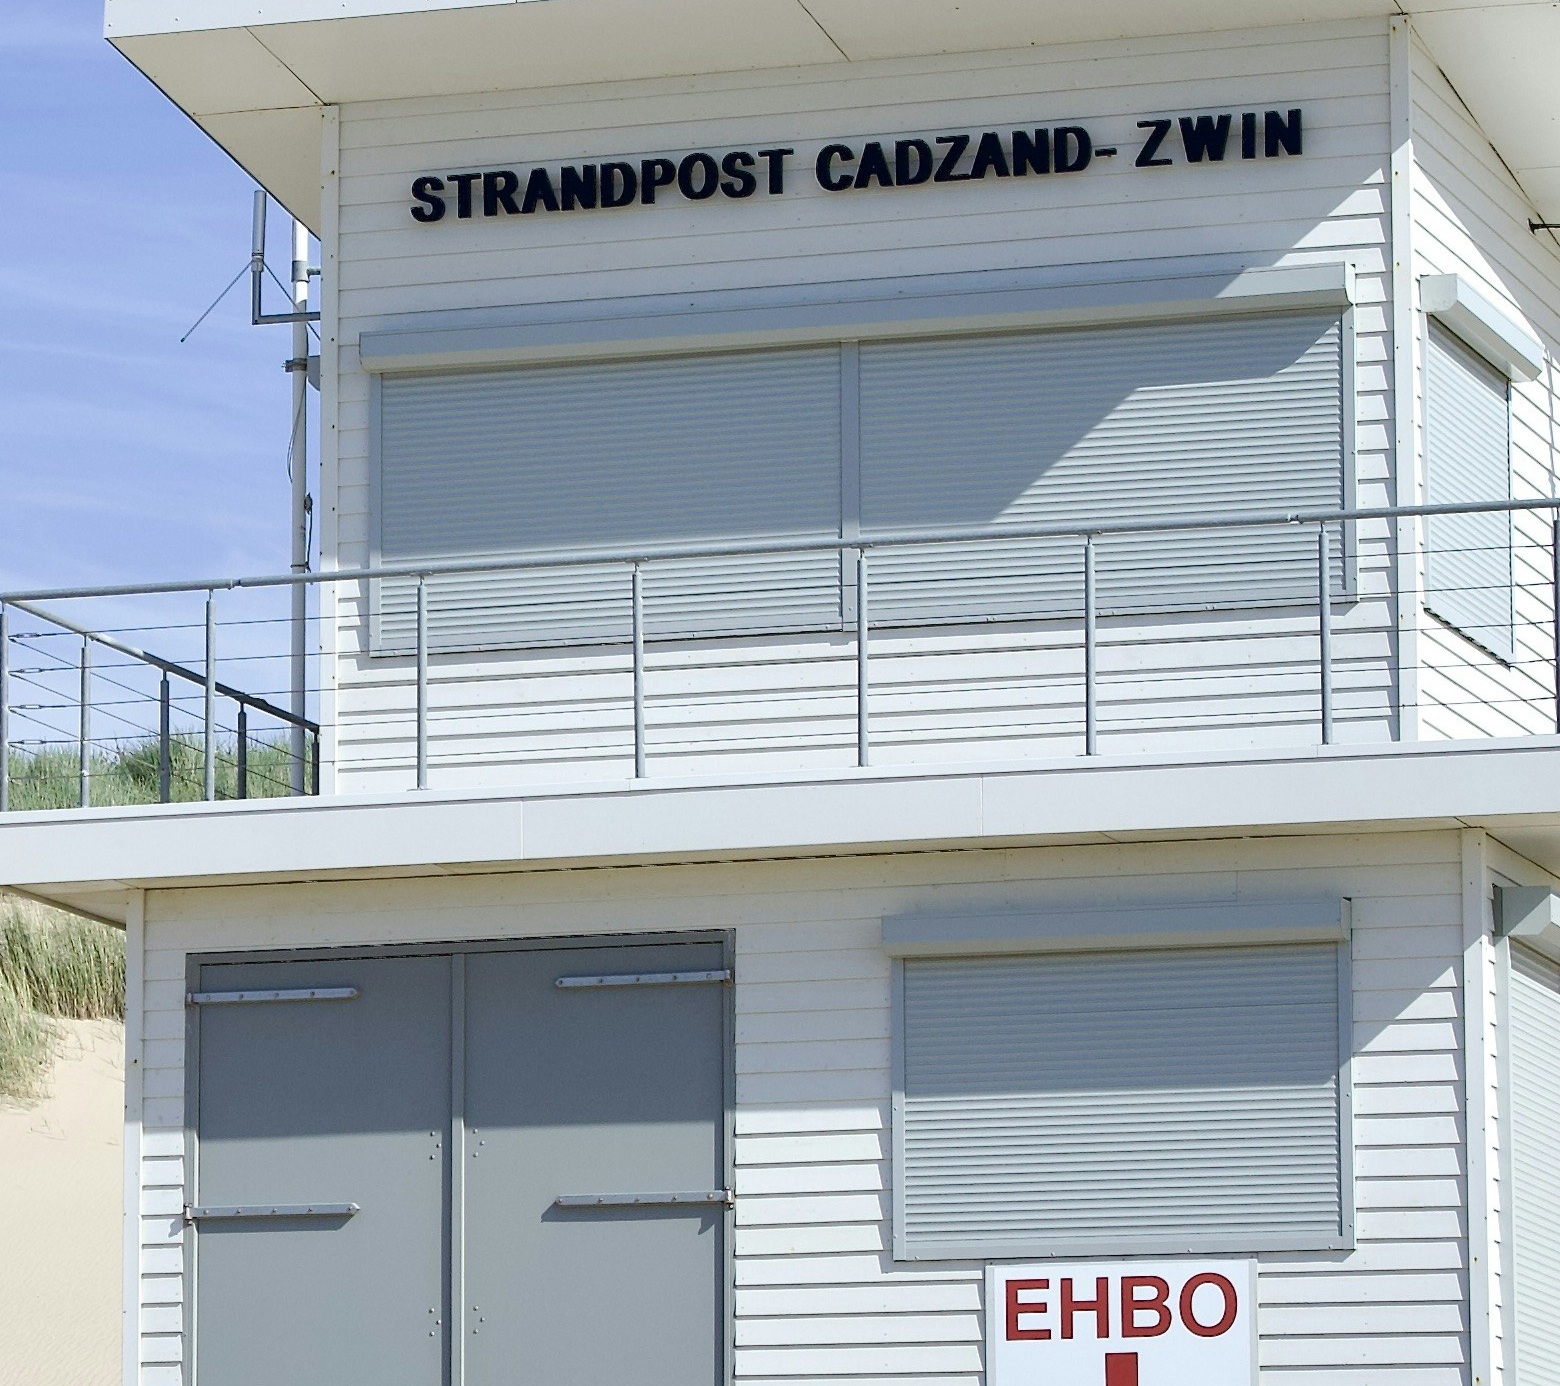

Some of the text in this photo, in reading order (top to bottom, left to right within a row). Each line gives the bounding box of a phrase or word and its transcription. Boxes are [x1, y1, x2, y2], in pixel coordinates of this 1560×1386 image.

[410, 148, 795, 223] STRANDPOST
[1134, 108, 1303, 168] ZWIN
[1005, 1272, 1238, 1341] EHBO
